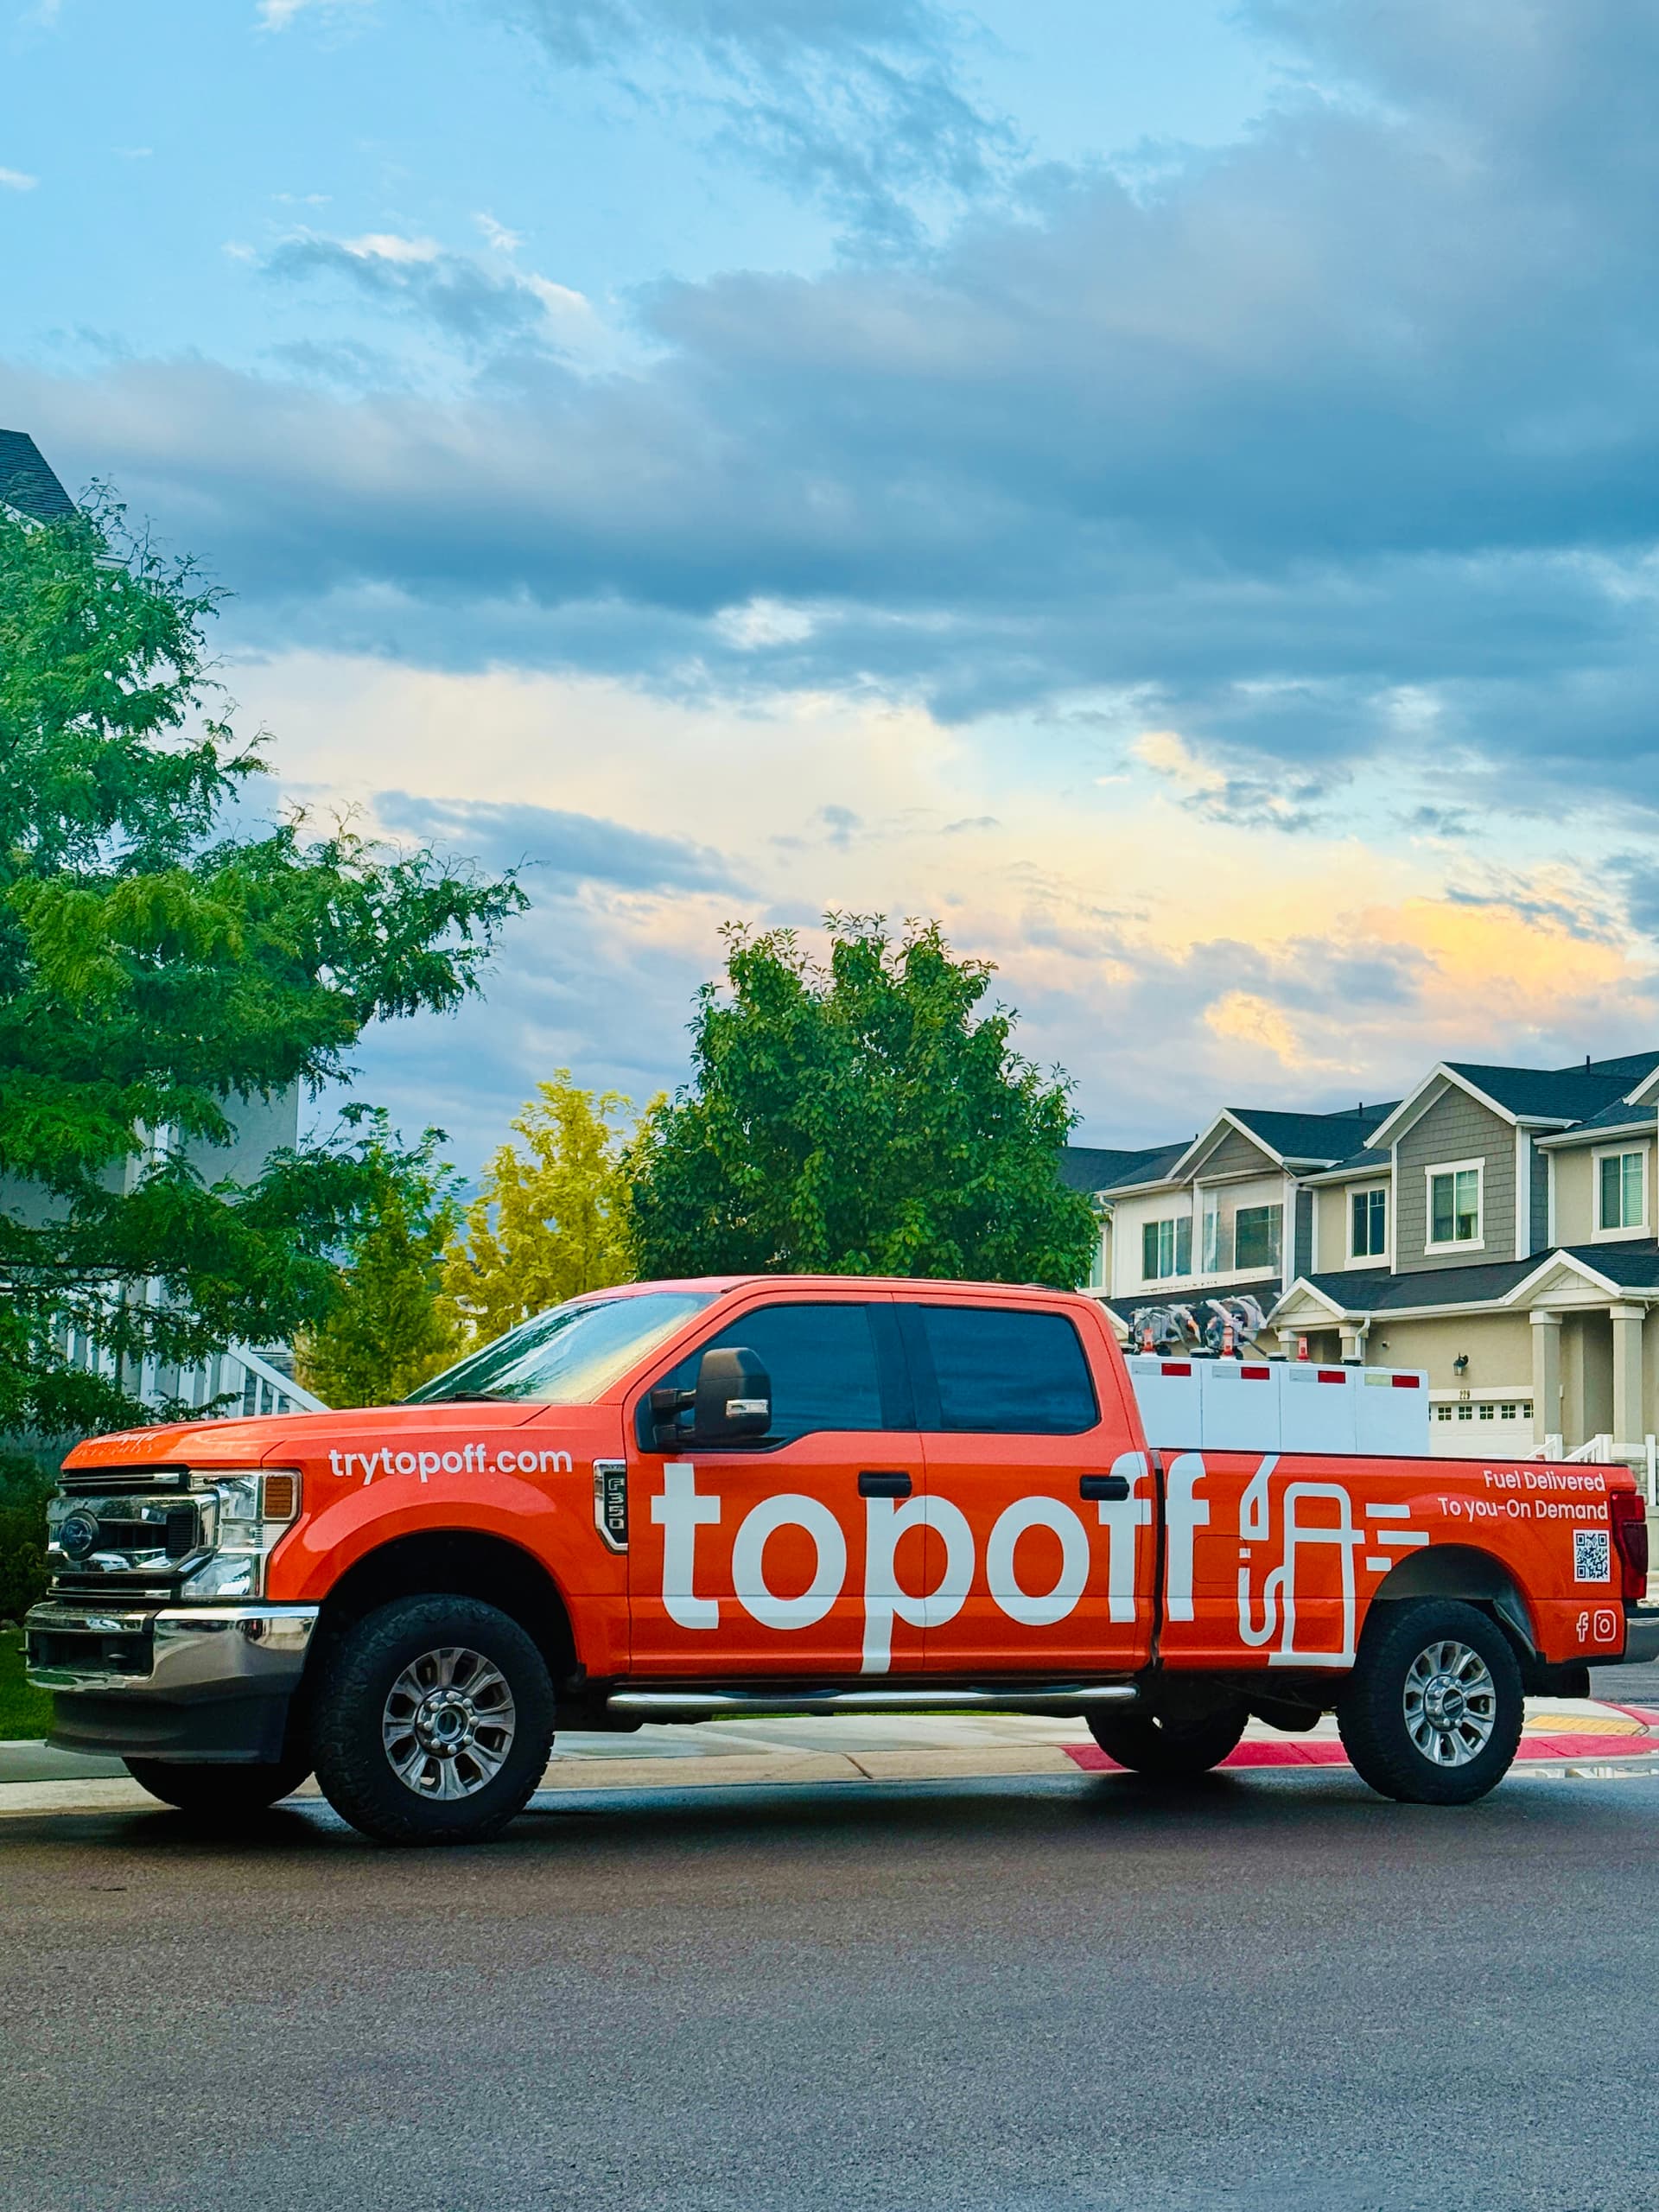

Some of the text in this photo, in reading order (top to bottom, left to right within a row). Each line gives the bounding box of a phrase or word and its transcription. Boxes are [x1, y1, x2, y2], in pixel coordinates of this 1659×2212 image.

[328, 1443, 573, 1485] trytopoff.com
[1484, 1470, 1606, 1491] Fuel Delivered
[607, 1478, 625, 1529] F350
[1438, 1497, 1608, 1522] To you-On Demand
[651, 1452, 1210, 1675] topoff
